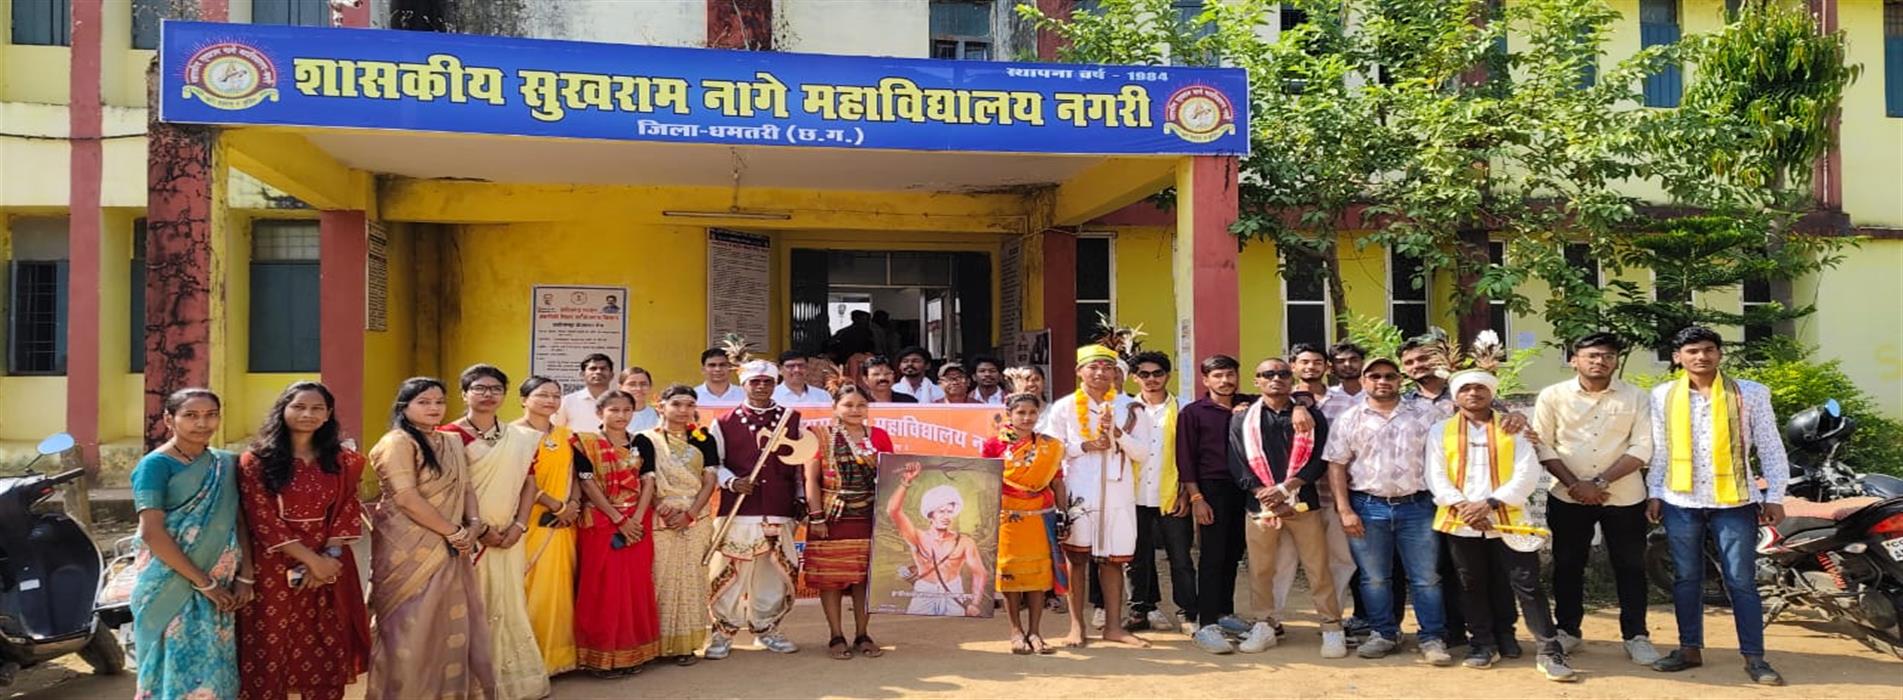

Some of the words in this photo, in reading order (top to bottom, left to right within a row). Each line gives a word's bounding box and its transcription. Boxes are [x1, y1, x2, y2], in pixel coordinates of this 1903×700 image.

[1006, 66, 1073, 79] स्थापना
[1079, 67, 1106, 81] वर्ष
[1127, 71, 1169, 82] 1984
[293, 53, 506, 105] शासकीय
[517, 69, 691, 121] सुखराम
[701, 72, 791, 118] नागे
[800, 77, 1045, 125] महाविद्यालय
[1054, 84, 1153, 127] नगरी
[637, 119, 779, 140] जिला-धमतरी
[785, 124, 865, 146] (छ.ग.)
